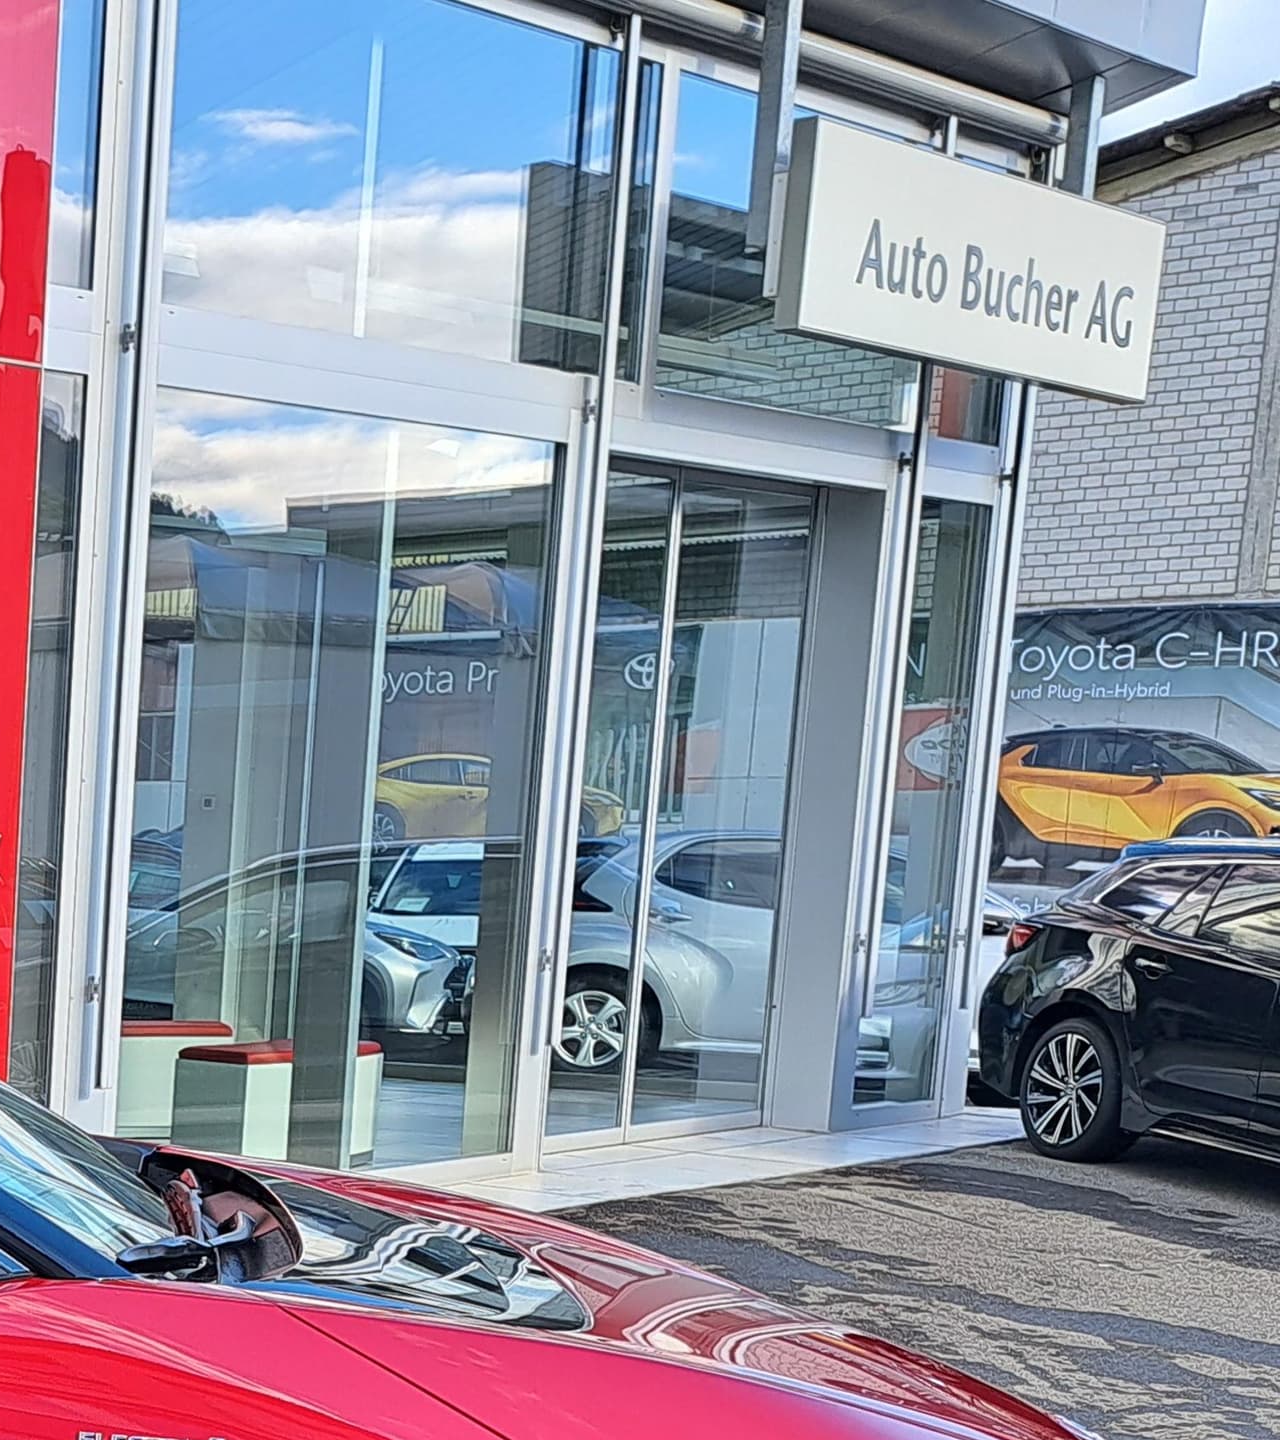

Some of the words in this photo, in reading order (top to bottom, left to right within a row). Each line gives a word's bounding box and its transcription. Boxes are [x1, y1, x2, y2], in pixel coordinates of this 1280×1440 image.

[856, 219, 948, 304] Auto
[960, 244, 1079, 334] Bucher
[1085, 279, 1135, 348] AG
[1155, 630, 1280, 670] C-HR
[467, 661, 500, 693] Pr
[1011, 685, 1041, 700] und
[1047, 681, 1171, 702] Plug-in-Hybrid
